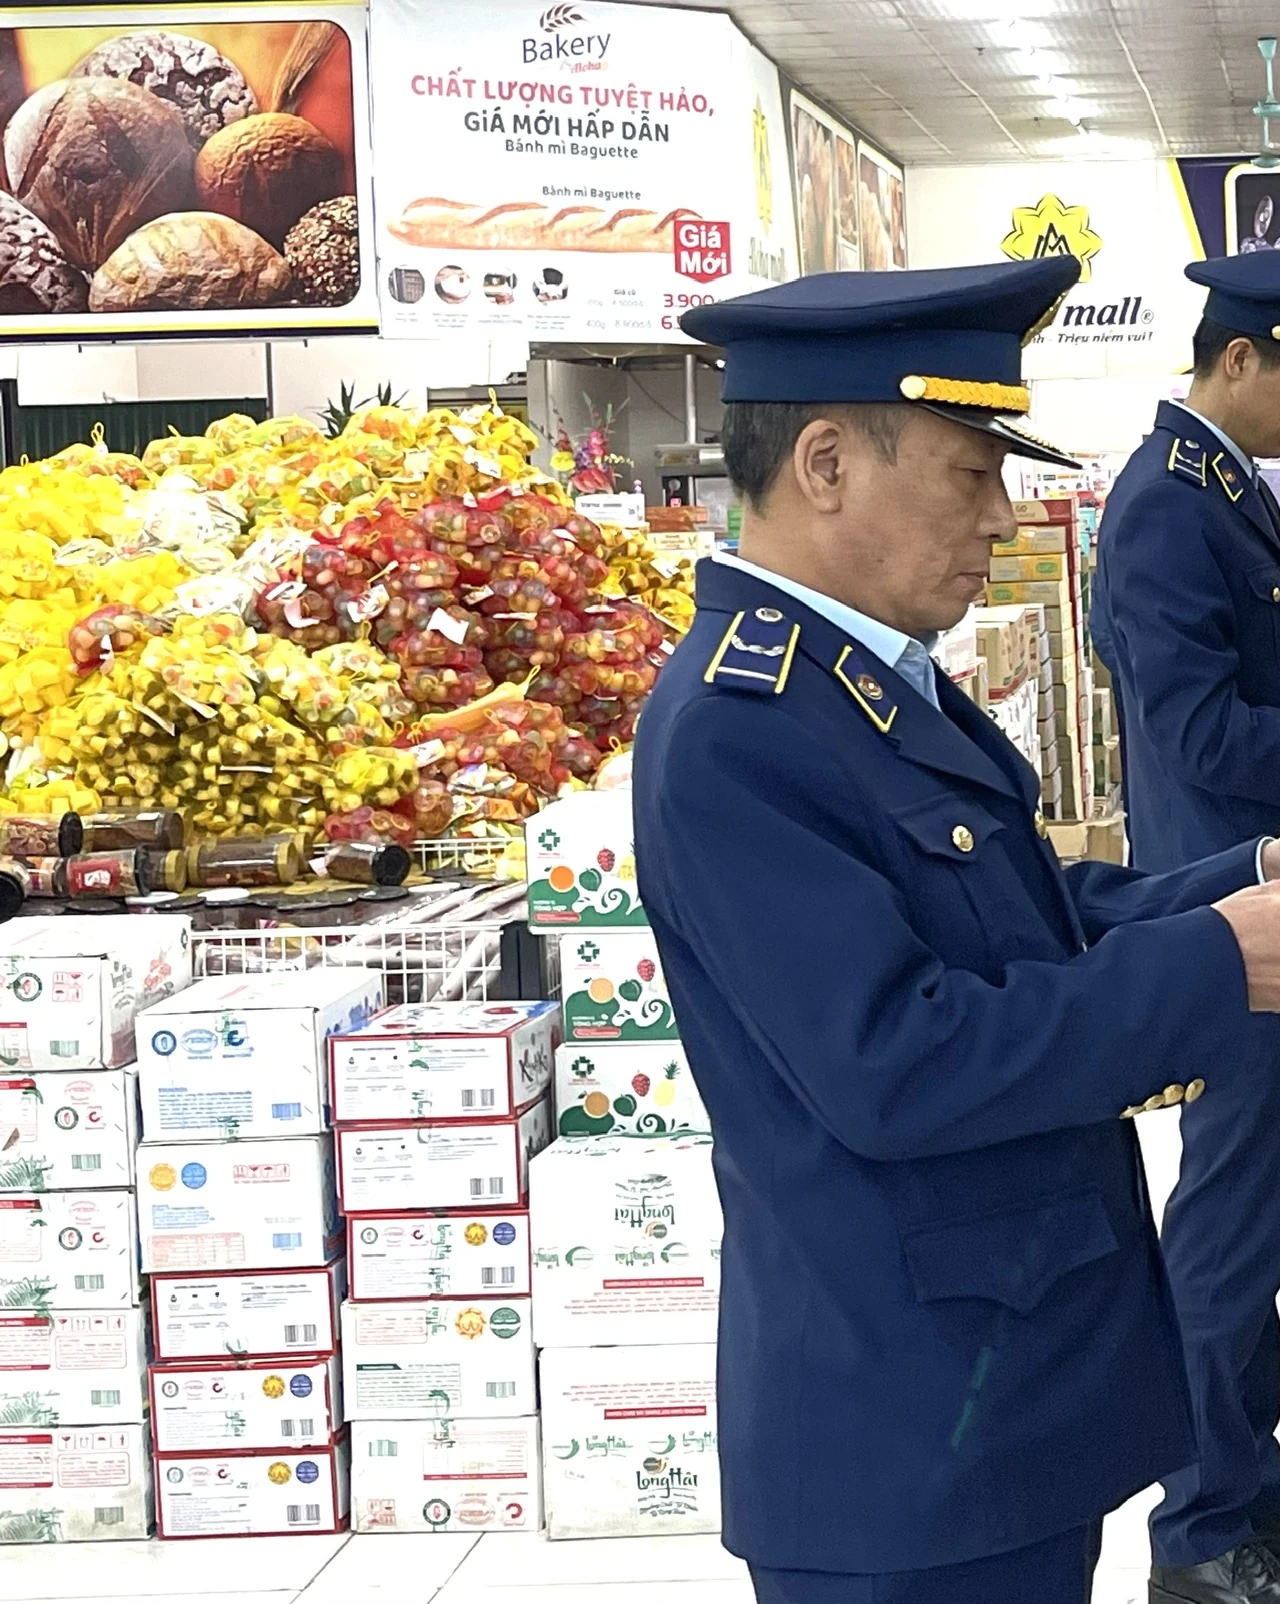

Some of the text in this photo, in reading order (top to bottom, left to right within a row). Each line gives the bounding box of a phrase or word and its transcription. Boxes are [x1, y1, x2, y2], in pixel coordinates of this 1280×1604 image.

[523, 33, 611, 64] Bakery
[411, 66, 714, 117] CHẤT LƯỢNG TUYỆT HẢO,
[513, 109, 560, 136] MỚI
[568, 108, 615, 139] HẤP
[622, 109, 669, 142] DẪN
[505, 138, 639, 160] Bánh mì Baguette
[542, 185, 641, 201] Bánh mì Baguette
[679, 223, 721, 248] Giá
[681, 250, 727, 275] Mới
[1063, 296, 1143, 327] mall
